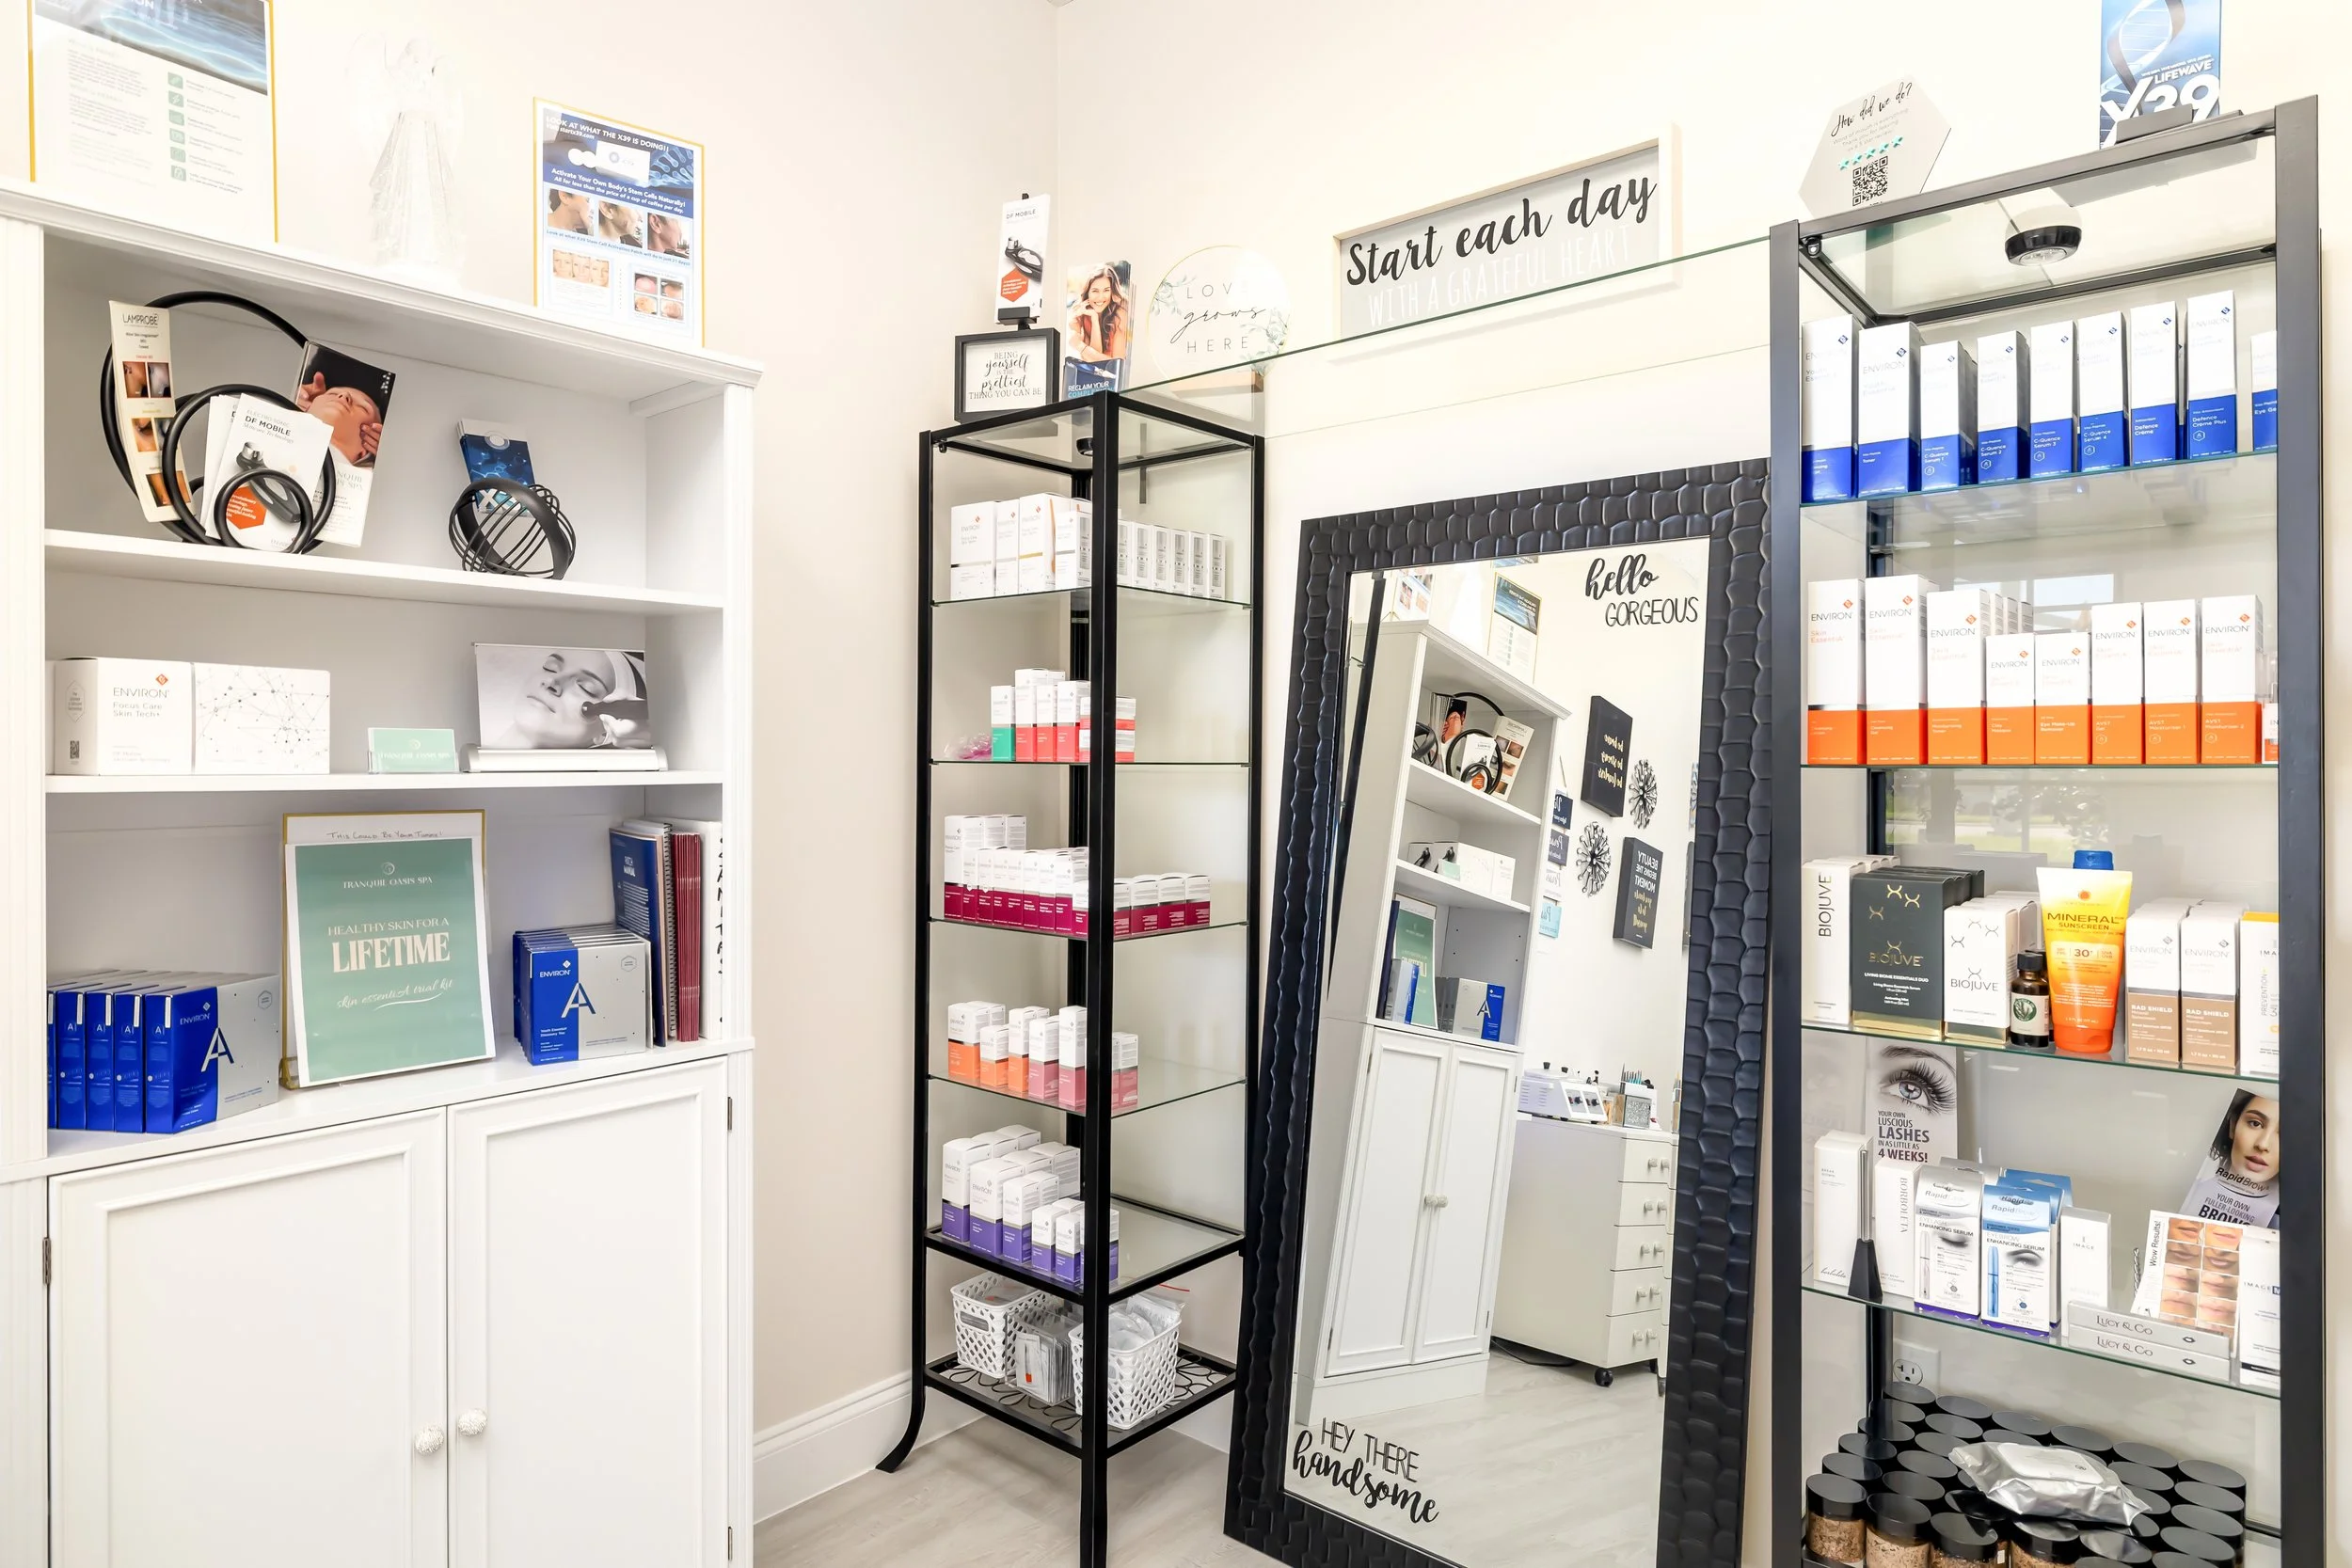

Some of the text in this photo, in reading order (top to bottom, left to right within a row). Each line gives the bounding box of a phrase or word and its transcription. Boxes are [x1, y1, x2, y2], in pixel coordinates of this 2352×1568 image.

[2154, 58, 2215, 85] LIFEWAVE
[1831, 82, 1913, 137] How did we do?
[2101, 74, 2220, 150] X39
[546, 117, 566, 127] LOOK
[580, 124, 601, 135] WHAT
[602, 131, 616, 139] THE
[640, 139, 670, 152] DOING!!
[560, 126, 595, 140] startx39.com
[551, 168, 686, 208] Activate Your Own Body's Stem Cells Naturally!
[583, 183, 596, 192] than
[606, 190, 619, 198] price
[647, 199, 663, 209] coffee
[664, 203, 673, 212] per
[1015, 209, 1037, 218] MOBILE
[1346, 177, 1658, 286] Start each day
[1368, 225, 1632, 328] WITH A GRATEFUL HEART
[122, 313, 158, 325] LAMPROBE
[1170, 307, 1266, 344] grows
[1187, 337, 1248, 354] HERE
[993, 352, 1018, 360] BEING
[985, 354, 1030, 377] yourself
[1863, 361, 1905, 374] ENVIRON
[982, 376, 1026, 395] prettiest
[1069, 380, 1109, 392] RECLAIM YOUR
[969, 387, 1042, 400] THING YOU CAN BE
[245, 416, 292, 436] DF MOBILE
[2192, 415, 2217, 423] Defence
[2083, 429, 2111, 438] C-Quence
[1981, 444, 2007, 452] C-Quence
[1585, 553, 1660, 600] hello
[1605, 596, 1699, 627] GORGEOUS
[1811, 612, 1852, 622] ENVIRON
[1869, 609, 1912, 620] ENVIRON
[1931, 628, 1976, 639] ENVIRON
[2096, 631, 2136, 640] ENVIRON
[2149, 628, 2191, 638] ENVIRON
[2205, 625, 2250, 634] ENVIRON
[1991, 660, 2028, 669] ENVIRON
[2042, 658, 2079, 667] ENVIRON
[113, 687, 167, 699] ENVIRON
[113, 702, 163, 711] Focus Care
[343, 876, 433, 890] TRANQUIL OASIS SPA
[1819, 874, 1835, 938] BIOJUVE
[2047, 912, 2120, 925] MINERAL
[328, 917, 450, 937] HEALTHY SKIN FOR A
[2058, 923, 2109, 931] SUNSCREEN
[332, 932, 451, 974] LIFETIME
[2130, 944, 2172, 955] ENVIRON
[2185, 948, 2230, 958] ENVIRON
[1868, 952, 1923, 967] BIOJUVE
[540, 970, 571, 978] ENVIRON
[1951, 978, 1999, 991] BIOJUVE
[337, 978, 453, 1009] skin trial kit
[561, 982, 596, 1019] A
[180, 1013, 211, 1025] ENVIRON
[201, 1027, 235, 1072] A
[1878, 1117, 1913, 1128] LUSCIOUS
[1879, 1126, 1930, 1143] LASHES
[1894, 1141, 1911, 1149] LITTLE
[1878, 1148, 1928, 1164] 4 WEEKS!
[2216, 1167, 2266, 1192] RapidBrow
[1899, 1178, 1909, 1233] BORBOLETA
[2205, 1196, 2255, 1223] FULLER-LOOKING
[2217, 1193, 2250, 1212] YOUR OWN
[1919, 1222, 1974, 1237] ENHANCING SERUM
[1987, 1232, 2020, 1243] EYEBROW
[2149, 1221, 2162, 1267] Wow Results!
[1987, 1238, 2045, 1252] ENHANCING SERUM
[2244, 1281, 2271, 1291] IMAGE
[2122, 1320, 2134, 1332] &
[2122, 1341, 2134, 1353] &
[1321, 1417, 1420, 1483] HEY THERE
[1293, 1430, 1439, 1524] handsome
